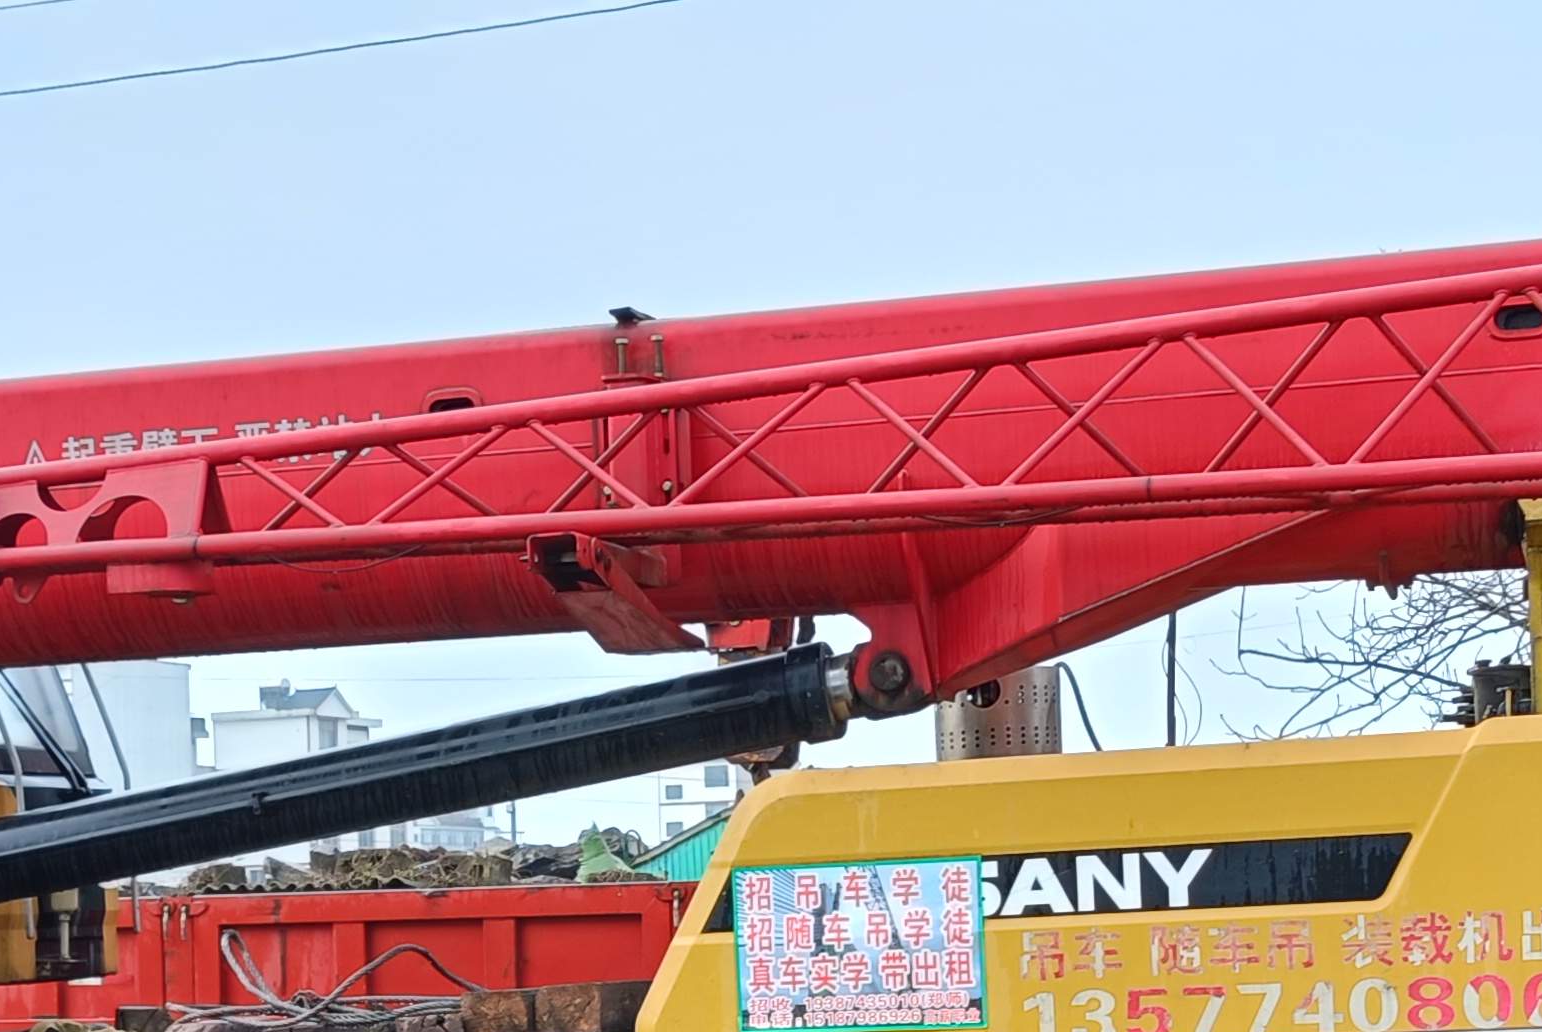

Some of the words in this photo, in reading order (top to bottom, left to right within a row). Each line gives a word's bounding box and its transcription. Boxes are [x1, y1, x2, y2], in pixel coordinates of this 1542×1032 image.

[1021, 925, 1123, 980] 吊车
[1150, 919, 1315, 977] 随车吊
[1342, 911, 1514, 968] 装载机
